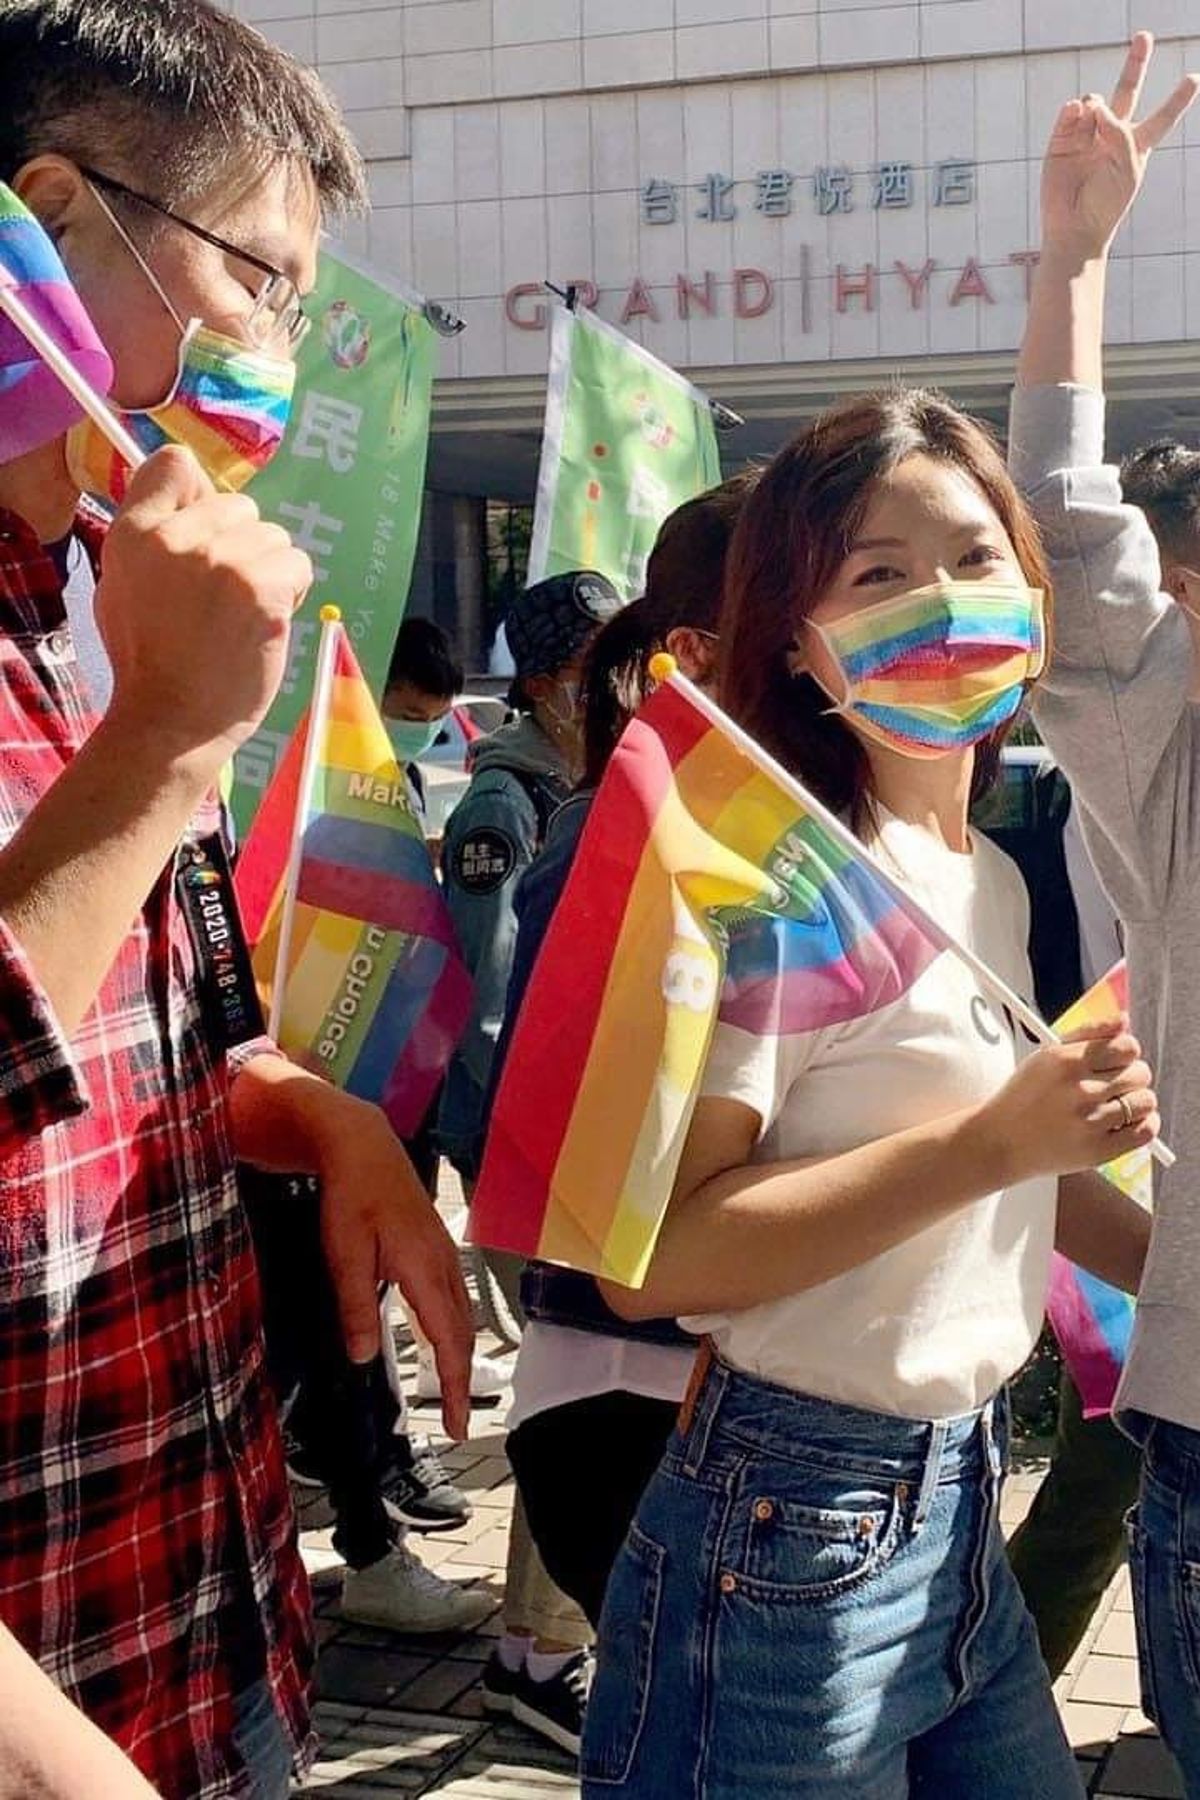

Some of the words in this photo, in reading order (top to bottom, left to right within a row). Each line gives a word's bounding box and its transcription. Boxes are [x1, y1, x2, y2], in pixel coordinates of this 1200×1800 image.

[504, 266, 775, 331] GRAND
[834, 249, 1041, 313] HYAT
[347, 772, 406, 812] Mak
